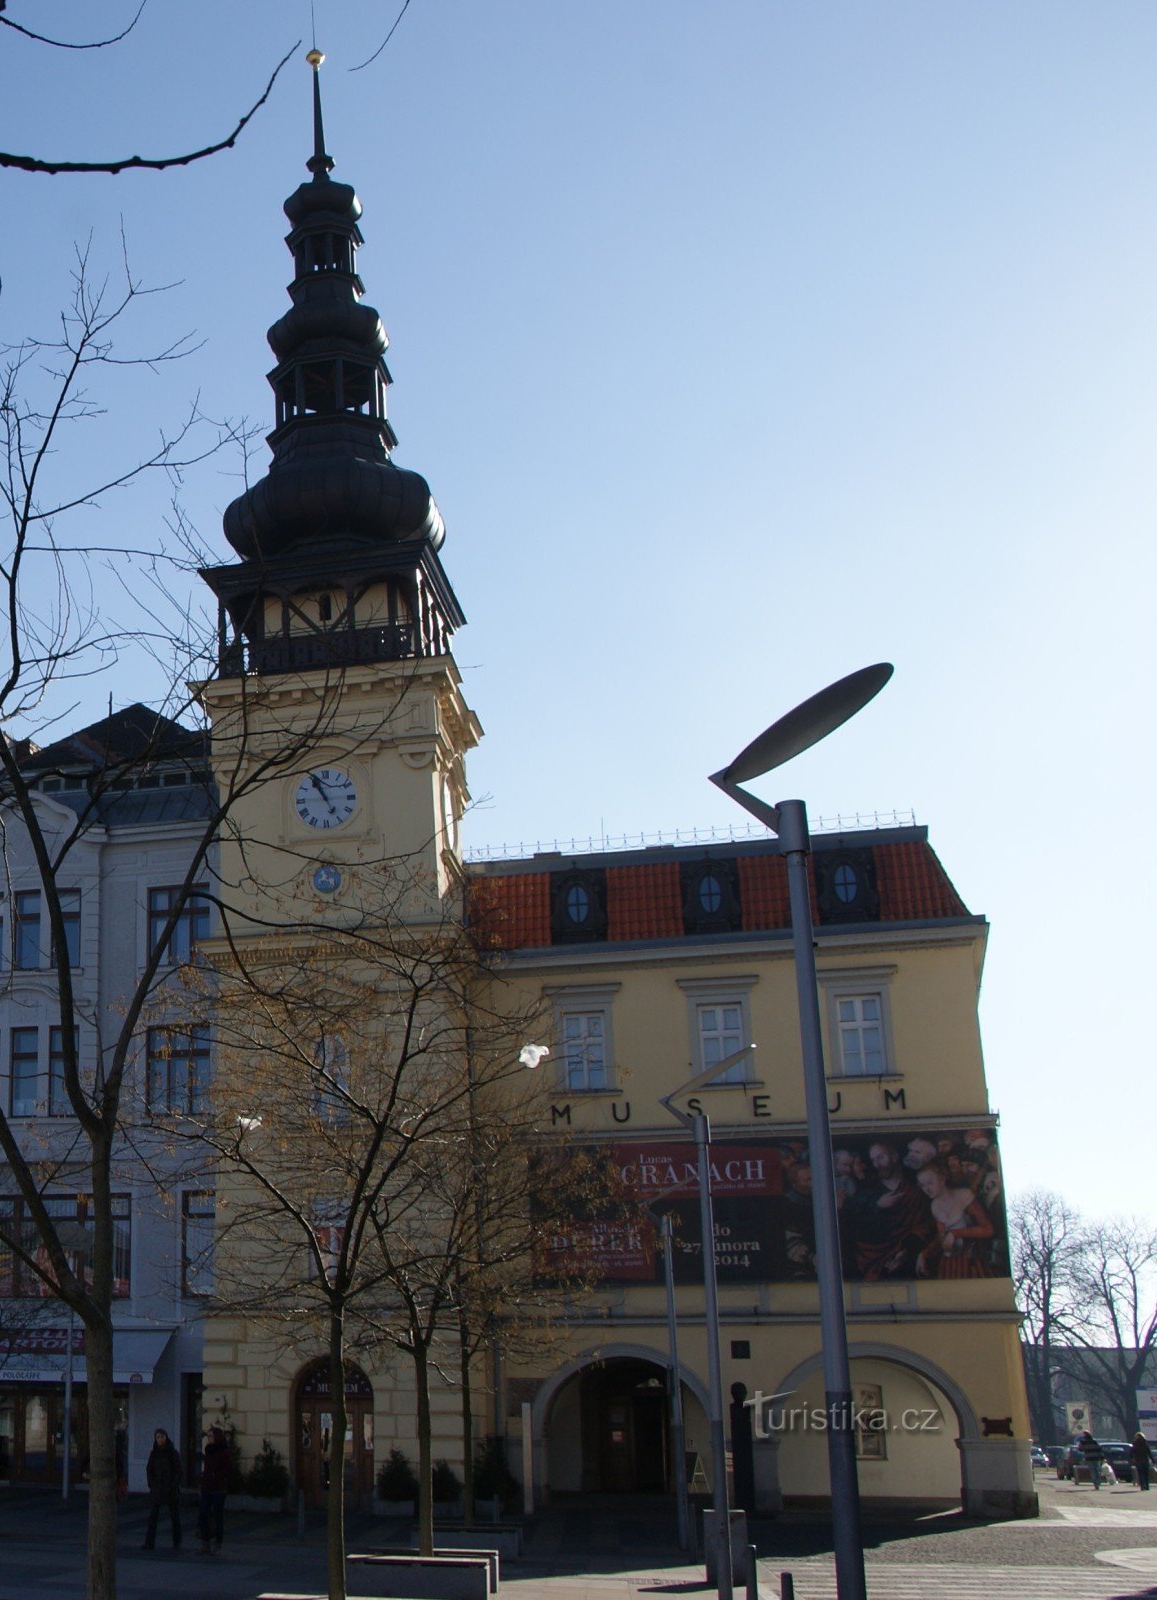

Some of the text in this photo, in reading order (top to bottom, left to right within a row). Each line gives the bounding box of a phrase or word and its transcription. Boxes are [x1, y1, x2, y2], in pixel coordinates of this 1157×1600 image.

[639, 1153, 673, 1164] Lucas
[620, 1159, 766, 1186] CRANACH
[682, 1242, 701, 1255] 27
[713, 1254, 751, 1267] 2014
